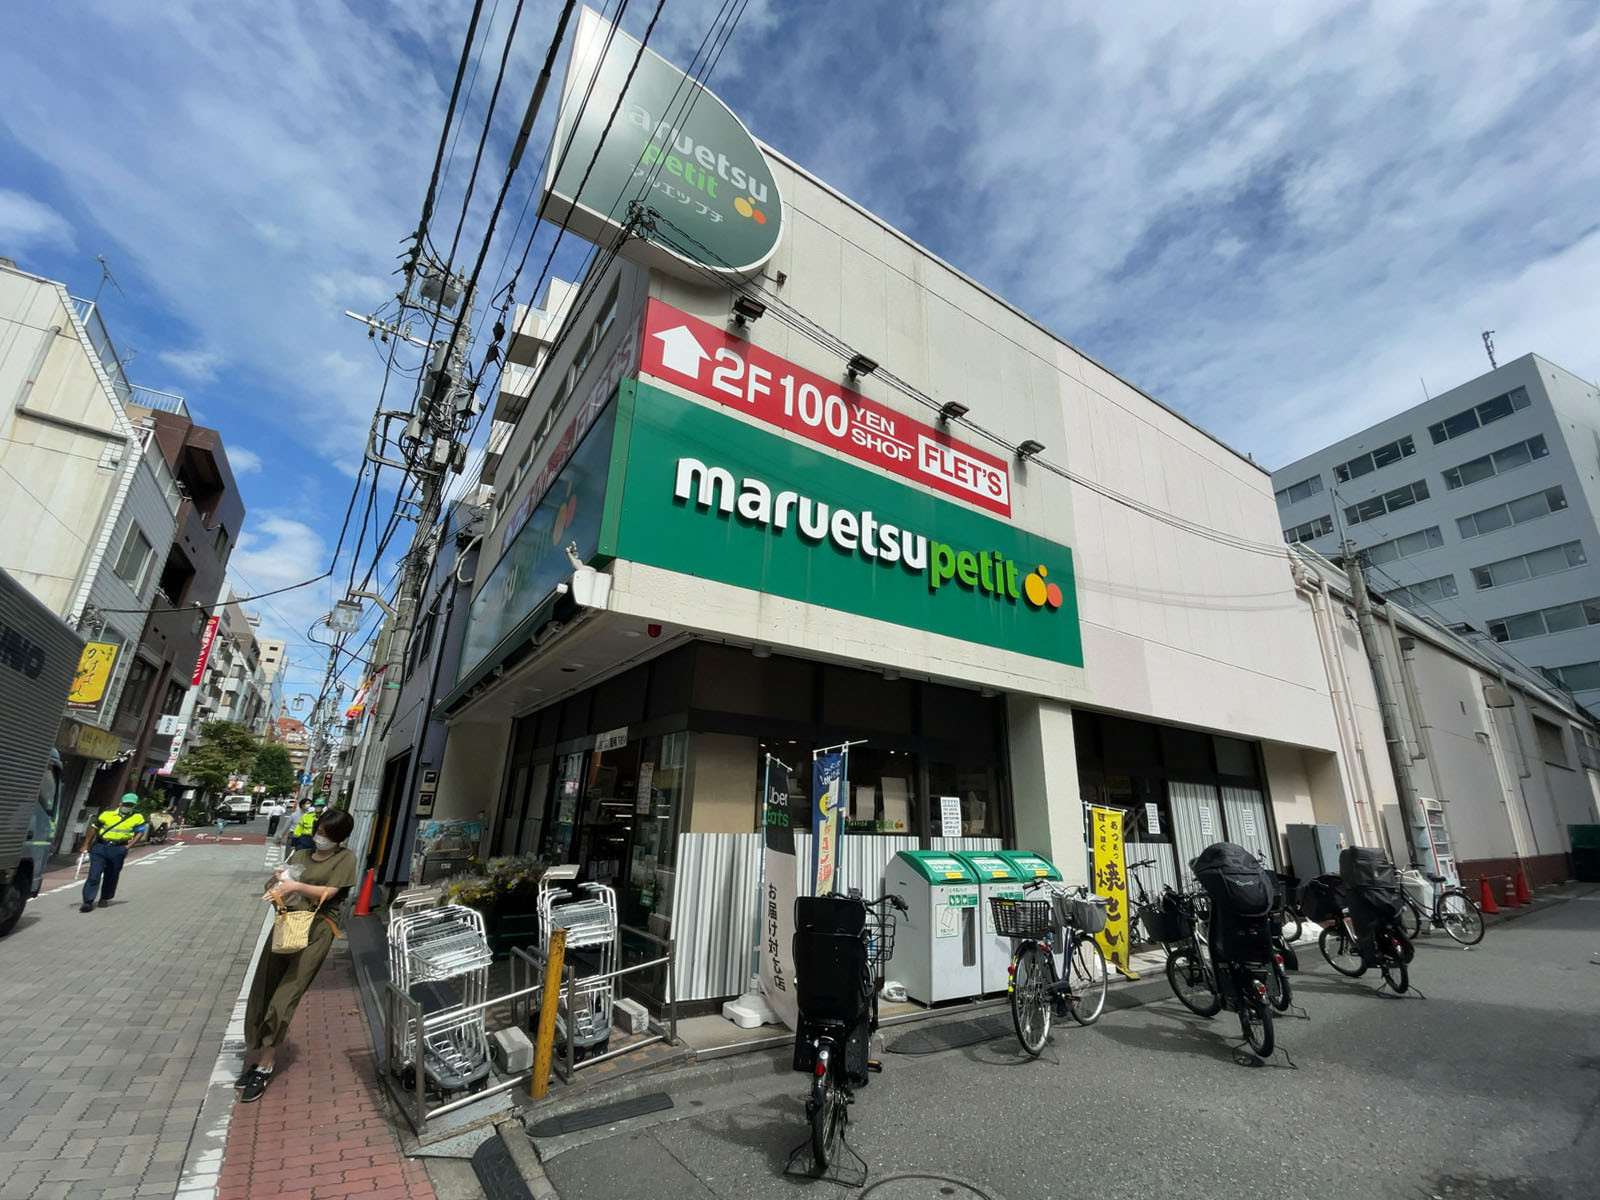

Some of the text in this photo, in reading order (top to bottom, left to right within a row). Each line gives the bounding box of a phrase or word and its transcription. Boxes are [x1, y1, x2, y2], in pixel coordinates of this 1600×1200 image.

[641, 139, 718, 198] petit
[712, 347, 848, 437] 2F 100
[851, 403, 895, 436] YEN
[851, 427, 912, 463] SHOP
[924, 444, 1003, 498] FLET'S
[675, 457, 927, 570] maruetsu
[929, 540, 1020, 599] petit
